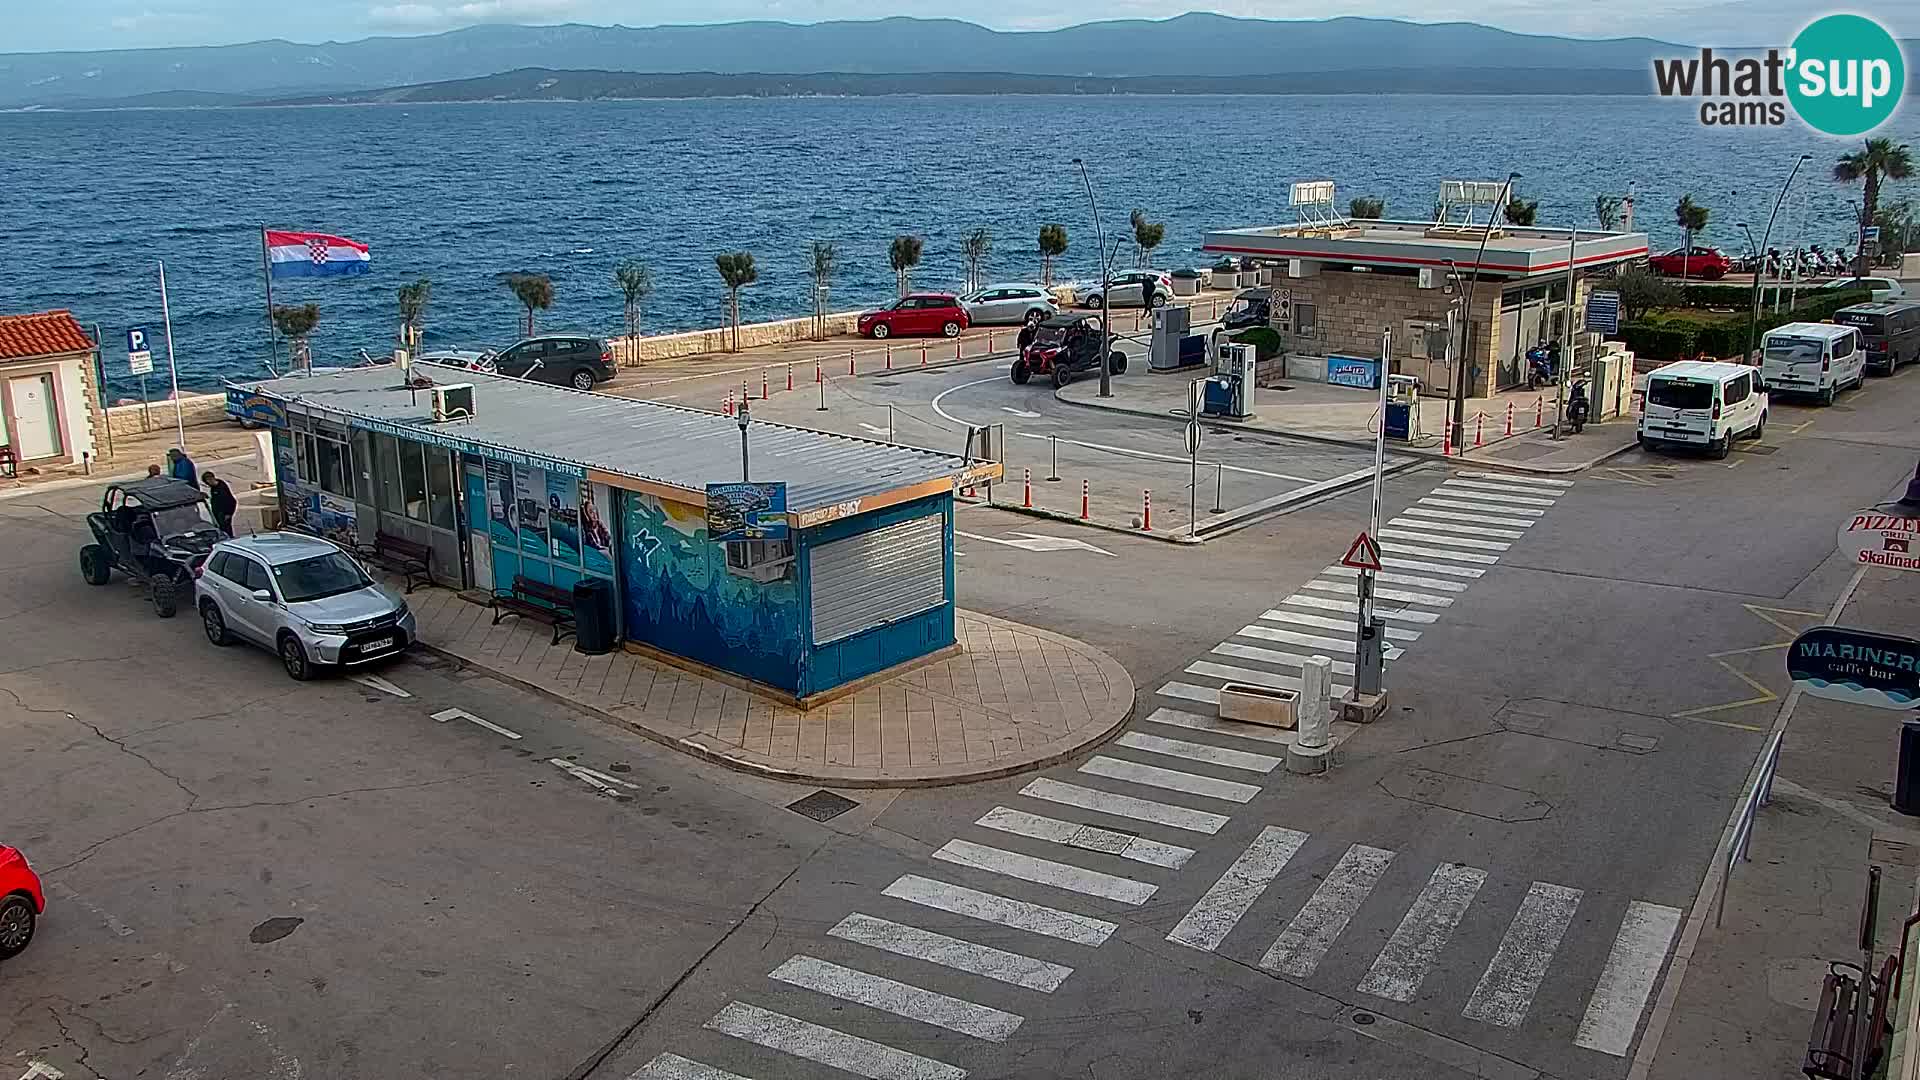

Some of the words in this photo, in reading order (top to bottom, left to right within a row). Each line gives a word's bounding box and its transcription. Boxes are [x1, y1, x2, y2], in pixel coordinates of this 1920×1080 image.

[131, 331, 144, 350] P
[397, 427, 437, 444] AUTOBUSNA
[437, 436, 469, 451] POSTAJA
[479, 446, 494, 457] BUS
[495, 449, 527, 464] STATION
[529, 456, 554, 470] TICKET
[556, 462, 583, 477] OFFICE
[1880, 530, 1916, 541] GRILL
[1828, 661, 1865, 675] caffe
[1869, 666, 1896, 680] bar
